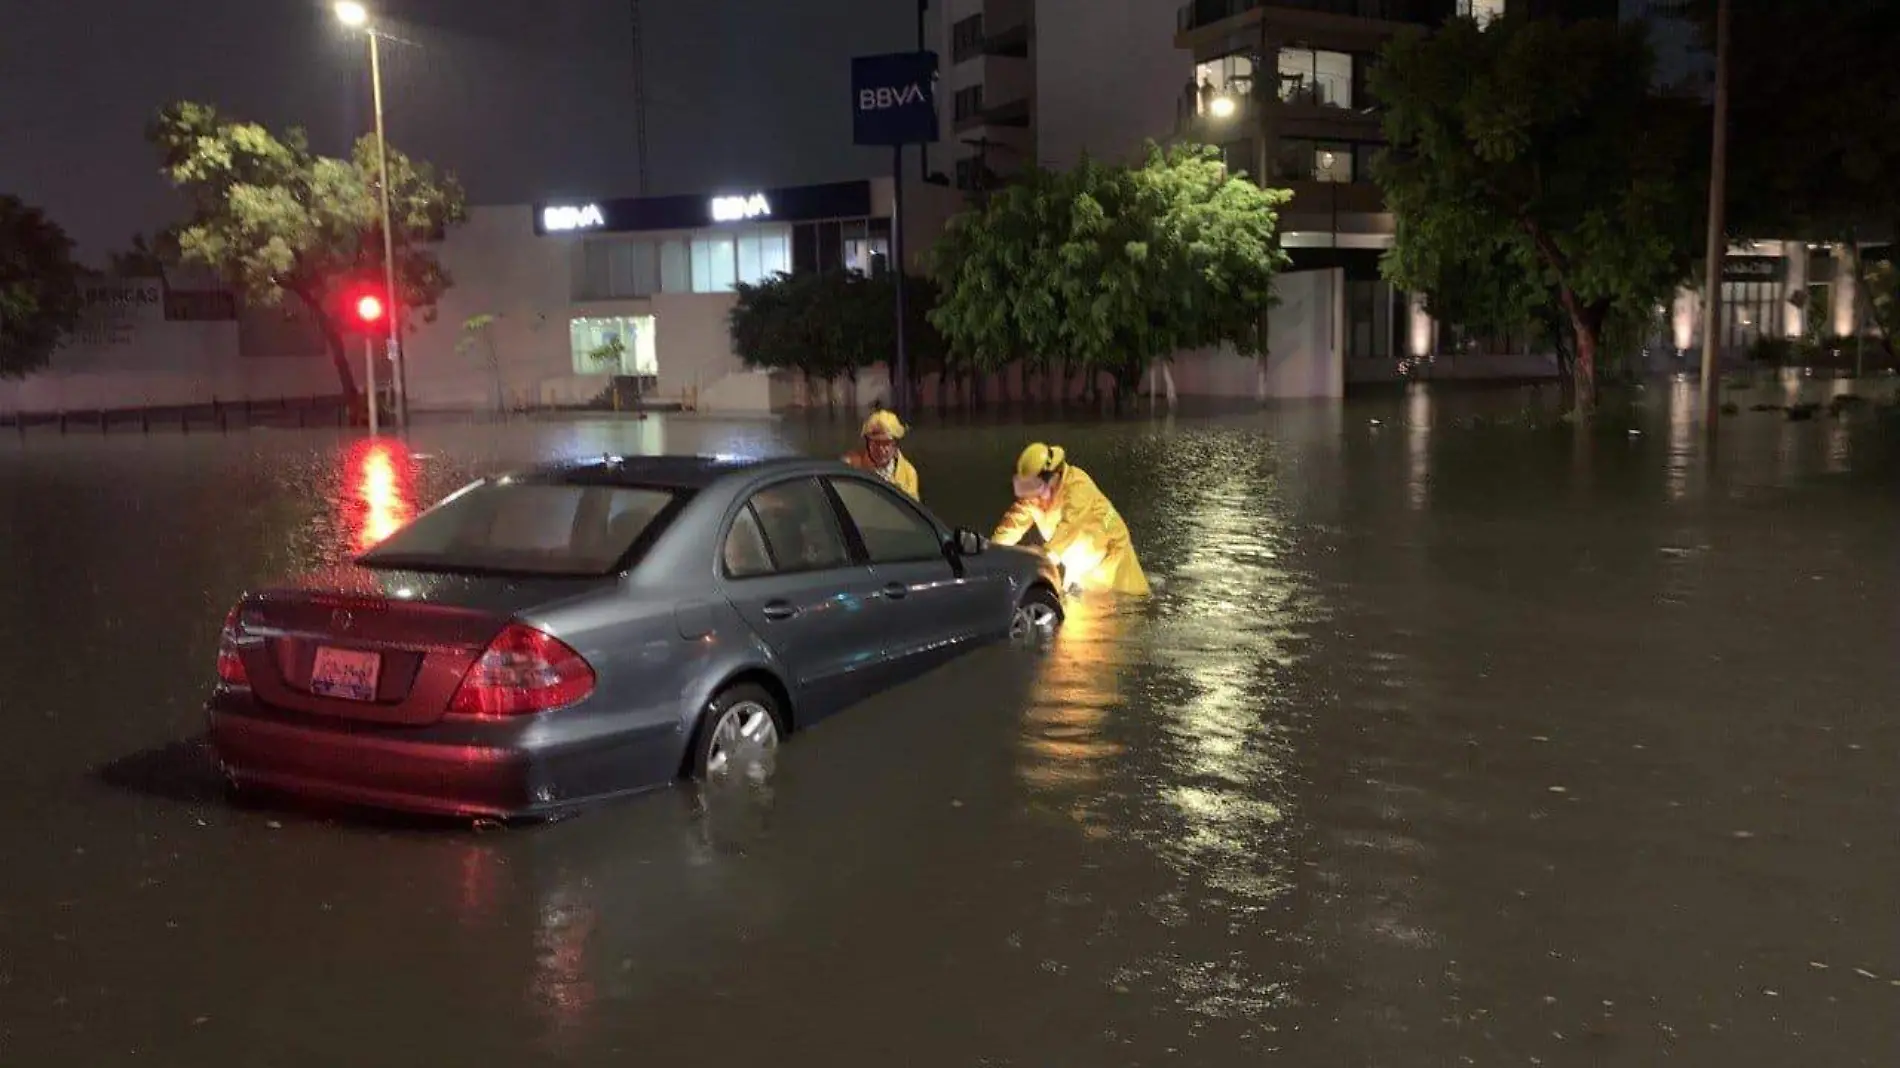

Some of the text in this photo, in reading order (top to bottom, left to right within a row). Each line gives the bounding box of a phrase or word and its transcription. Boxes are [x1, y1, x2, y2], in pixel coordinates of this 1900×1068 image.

[859, 82, 925, 110] BBVA
[544, 204, 604, 230] BBVA
[712, 193, 771, 221] BBVA
